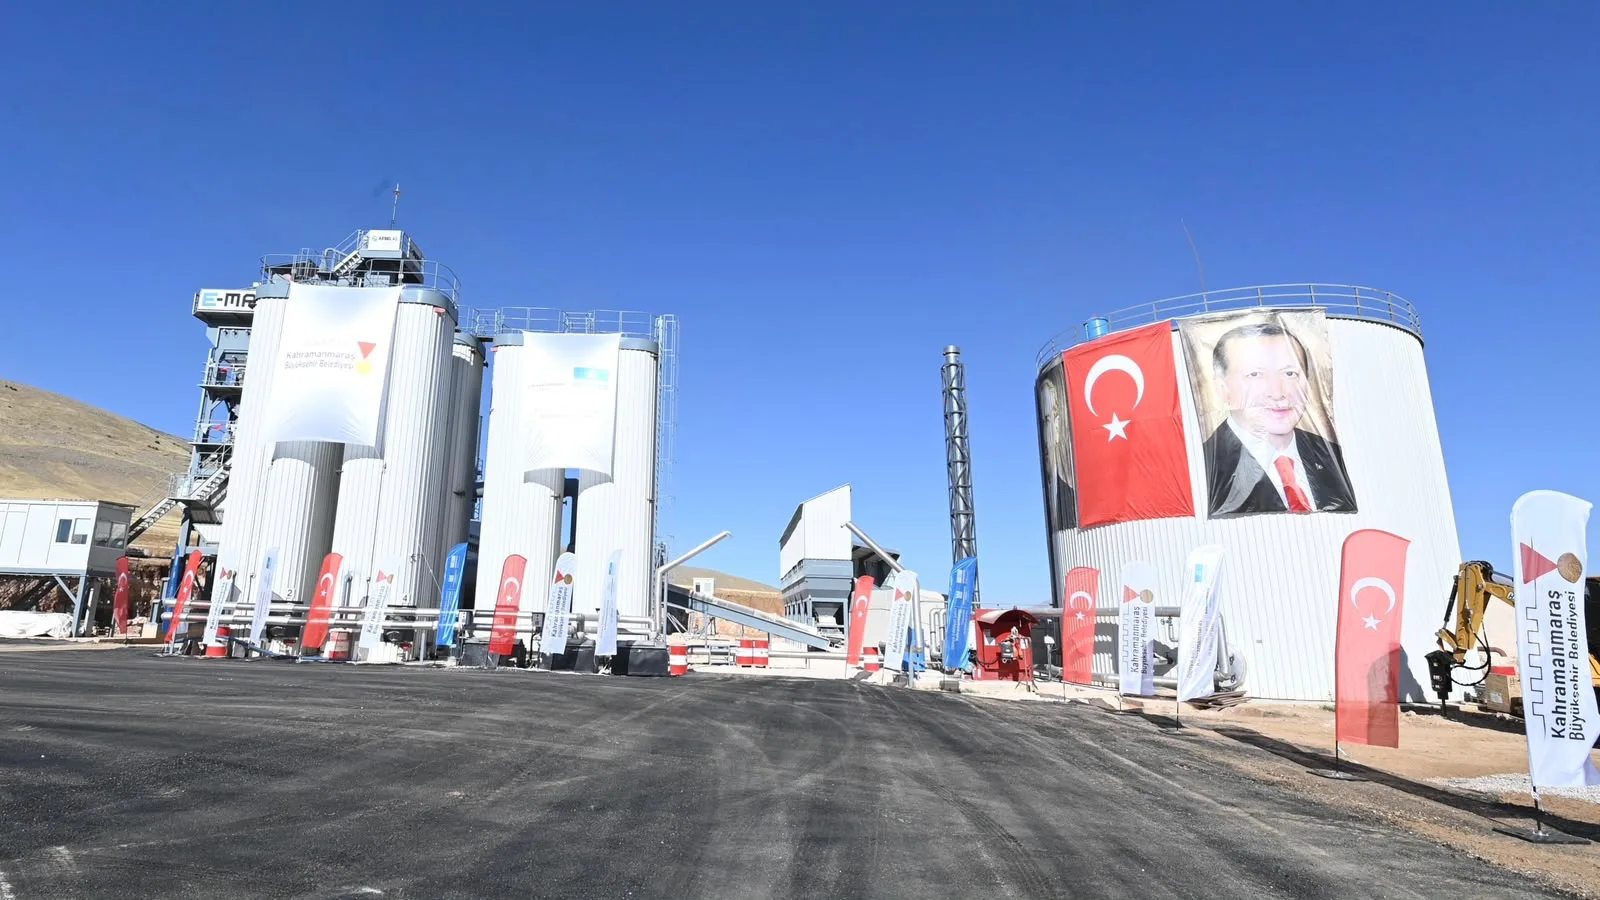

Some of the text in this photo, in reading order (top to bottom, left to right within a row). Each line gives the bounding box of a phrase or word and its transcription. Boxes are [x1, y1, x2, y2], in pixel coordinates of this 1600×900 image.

[287, 589, 293, 597] 2
[1130, 606, 1141, 673] Kahramanmaraş
[1547, 590, 1566, 739] Kahramanmaraş
[1566, 591, 1586, 741] Büyükşehir Belediyesi
